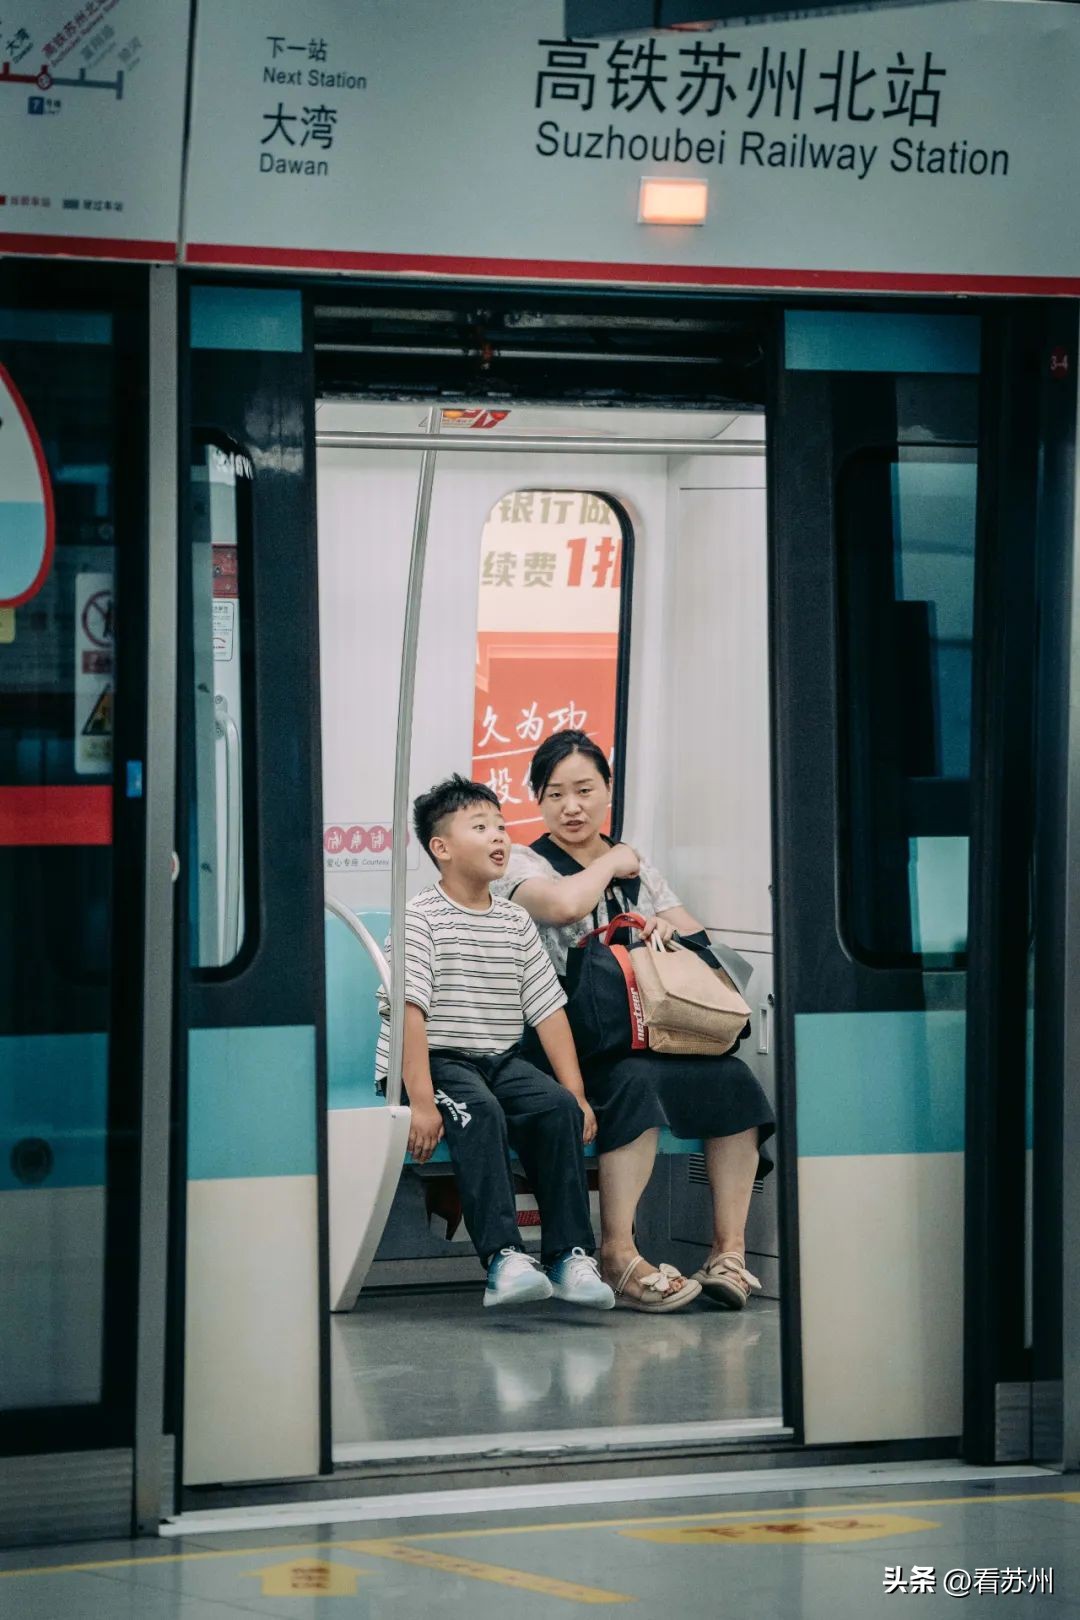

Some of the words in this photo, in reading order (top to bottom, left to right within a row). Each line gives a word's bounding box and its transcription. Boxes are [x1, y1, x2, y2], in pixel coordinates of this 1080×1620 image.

[266, 37, 328, 61] 下一站
[263, 66, 302, 86] Next
[308, 70, 367, 90] Station
[535, 37, 947, 129] 高铁苏州北站
[261, 102, 338, 150] 大湾
[259, 153, 329, 176] Dawan
[536, 120, 726, 165] Suzhoubei
[740, 131, 878, 180] Railway
[890, 137, 1009, 176] Station
